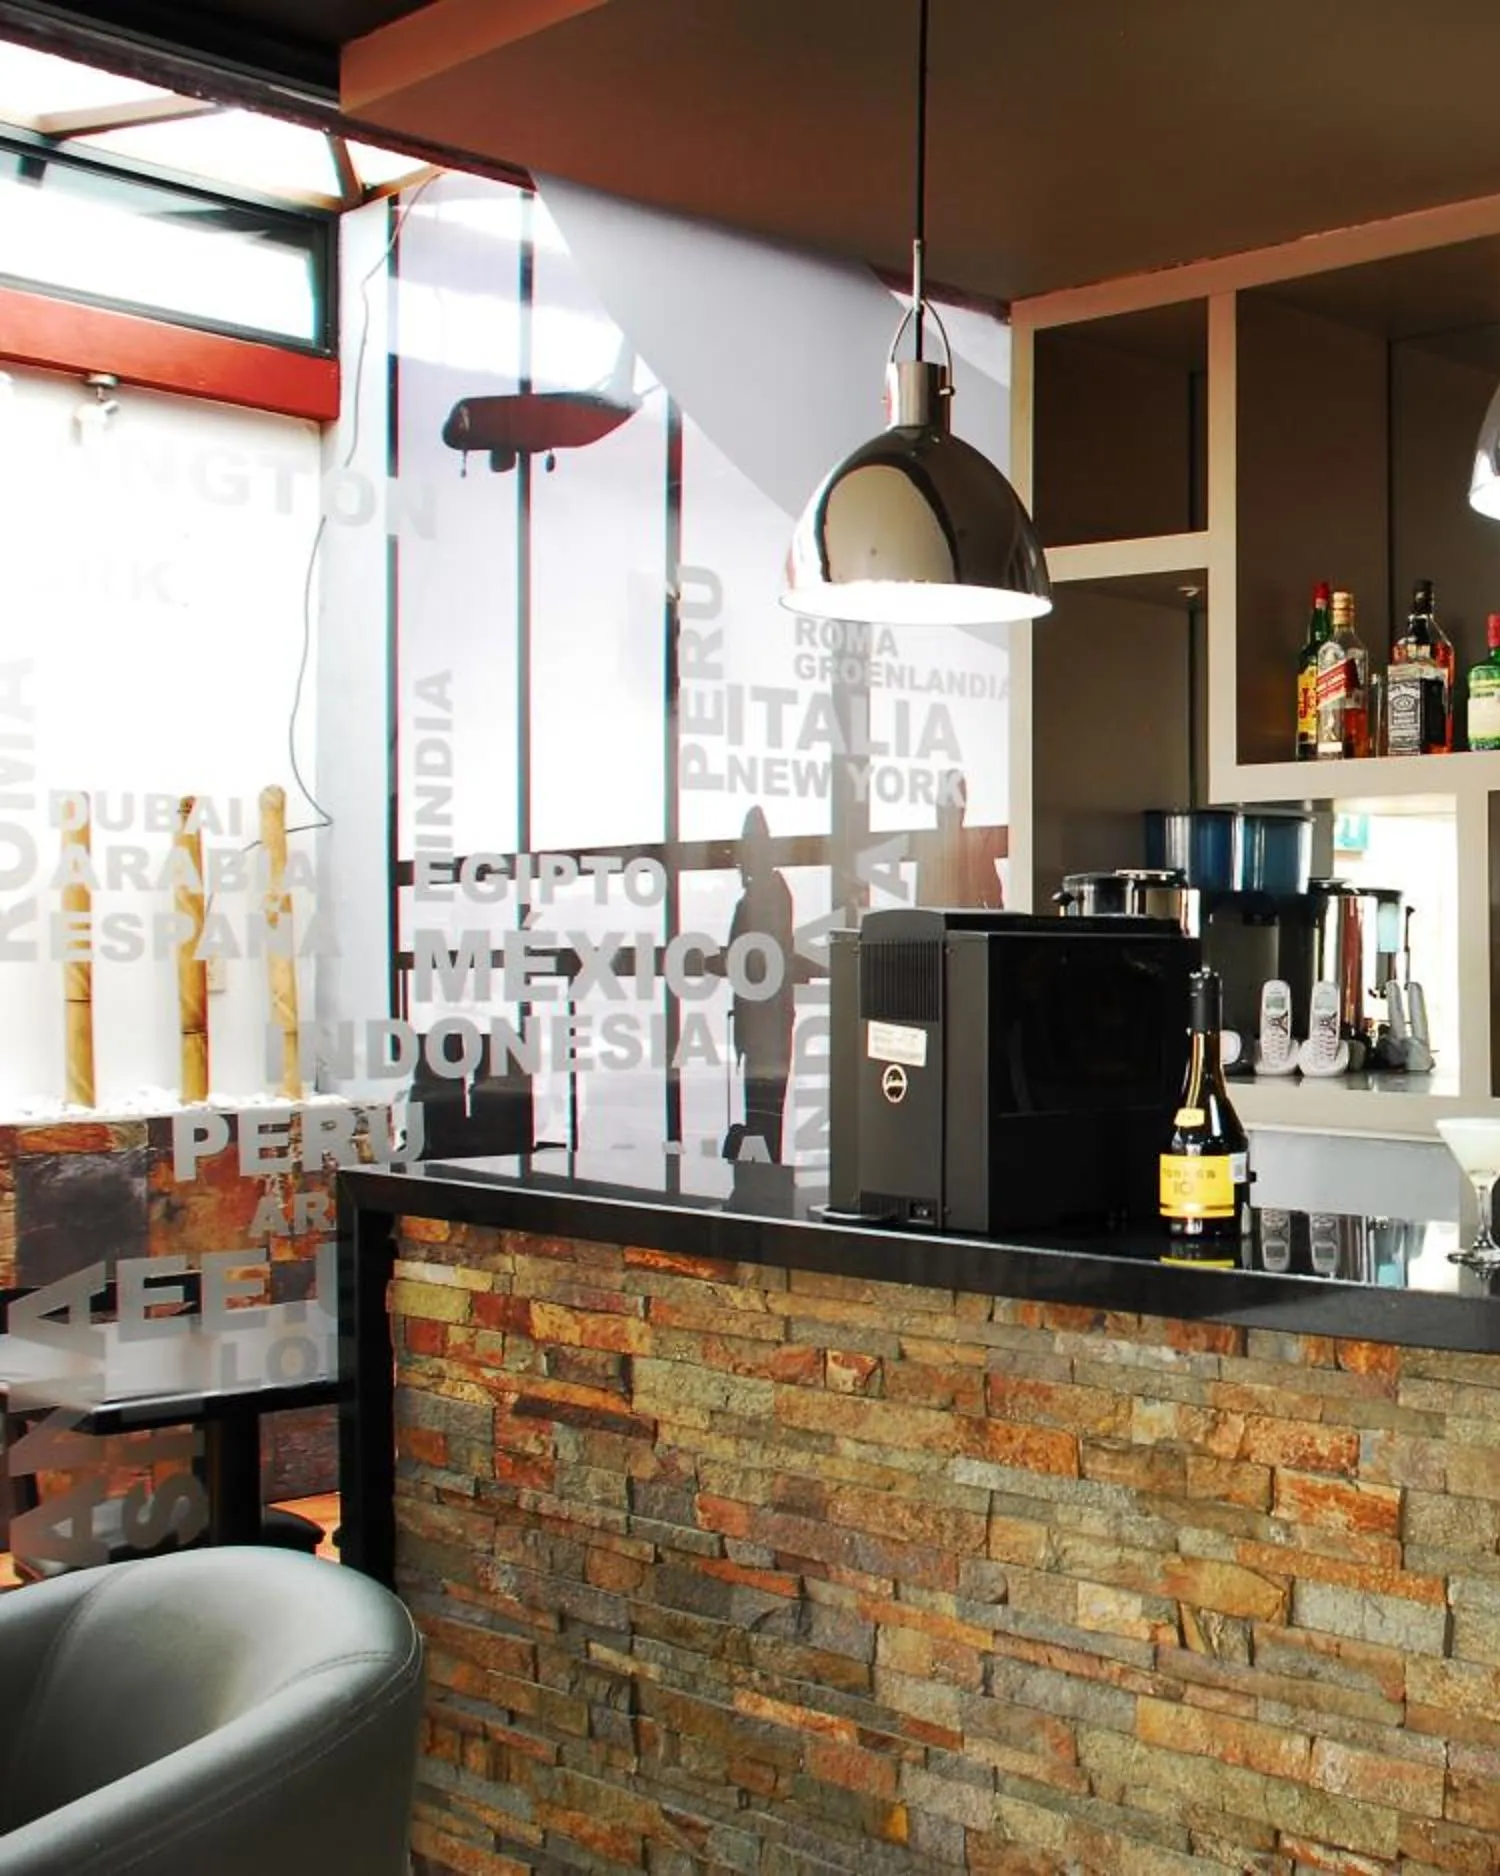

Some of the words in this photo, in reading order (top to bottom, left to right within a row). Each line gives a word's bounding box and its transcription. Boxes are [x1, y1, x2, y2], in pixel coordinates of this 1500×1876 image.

[794, 617, 899, 658] ROMA
[794, 653, 1010, 701] GROENLANDIA
[726, 683, 964, 763] ITALIA
[413, 670, 454, 848] INDIA
[727, 754, 831, 799] NEW
[847, 762, 966, 808] YORK
[49, 789, 243, 836] DUBAI
[49, 845, 318, 893] ARABIA
[414, 852, 669, 907] EGIPTO
[414, 911, 785, 1003] MÉXICO
[265, 1011, 722, 1084] INDONESIA
